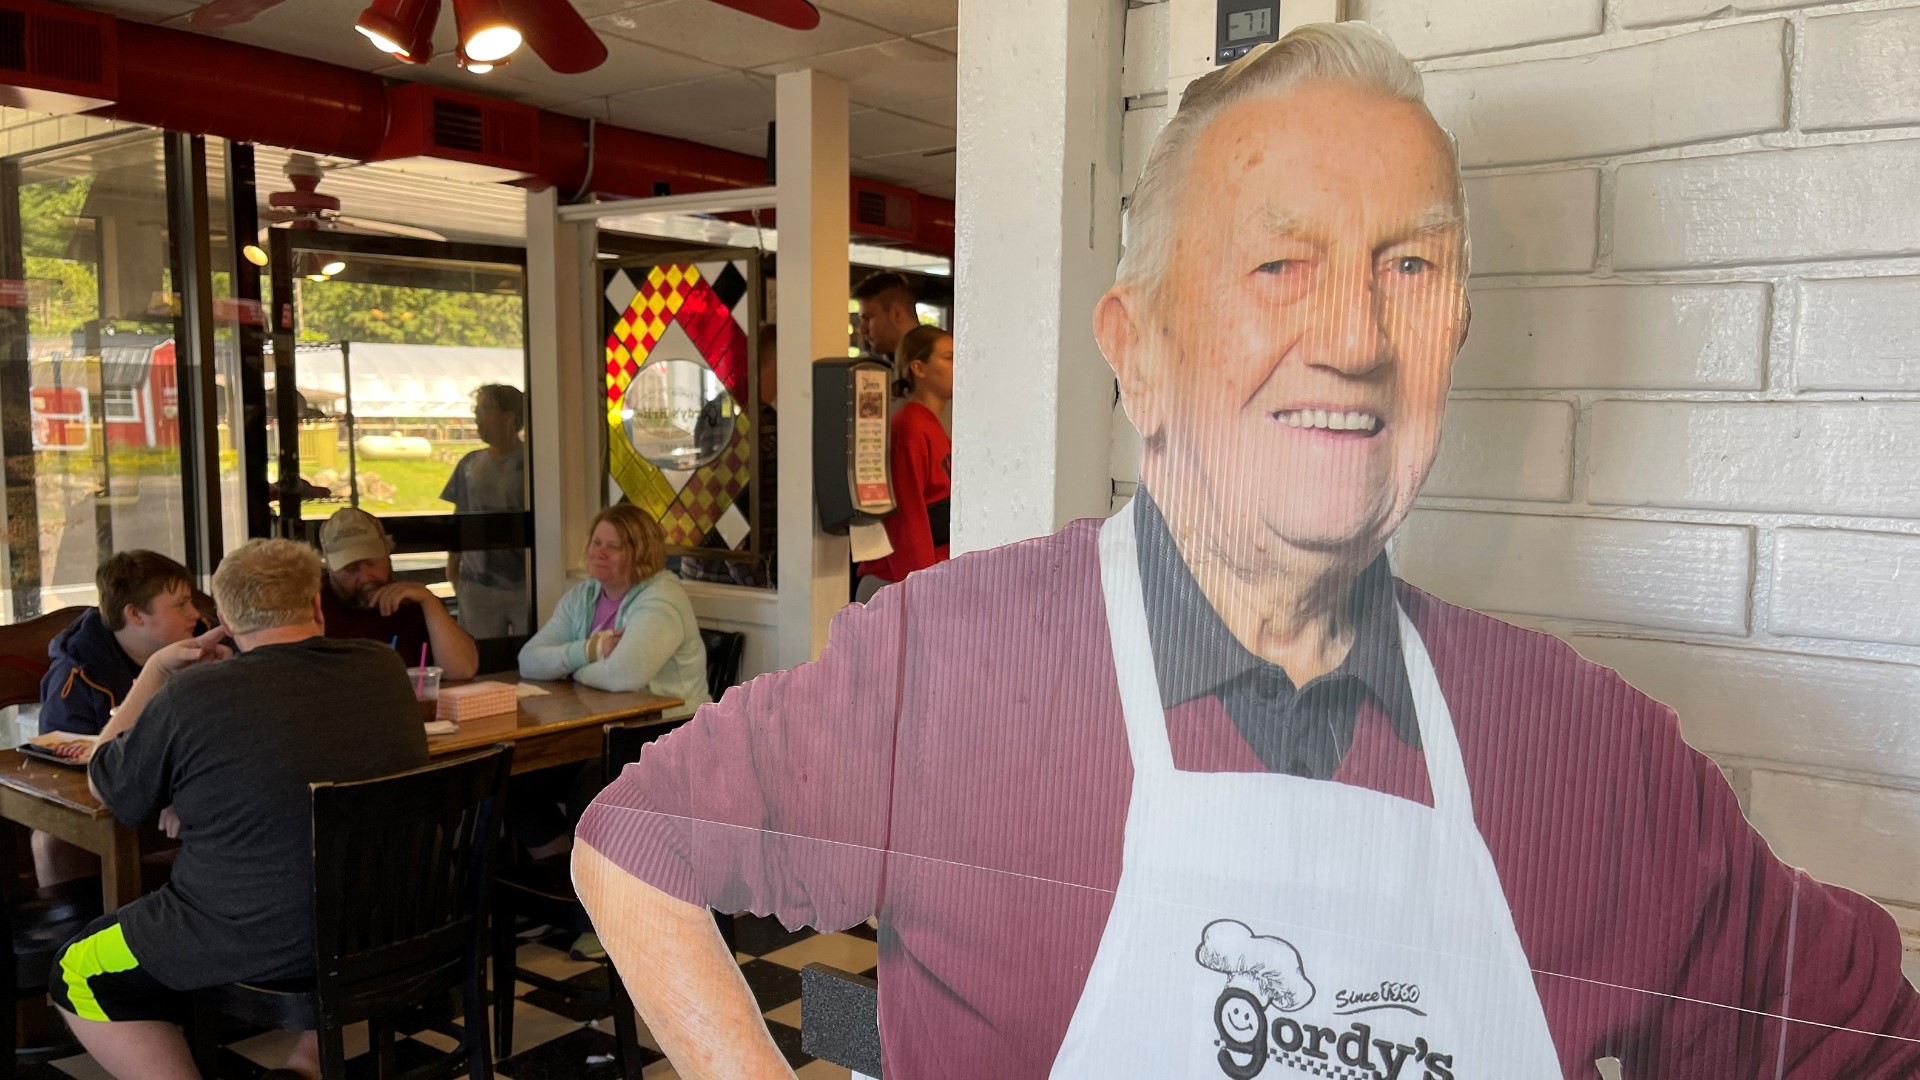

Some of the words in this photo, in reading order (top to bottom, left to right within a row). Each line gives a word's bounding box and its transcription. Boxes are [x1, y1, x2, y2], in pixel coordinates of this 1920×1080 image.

[1335, 989, 1380, 1008] Since
[1380, 981, 1420, 1003] 1960
[1214, 987, 1454, 1080] gordy's
